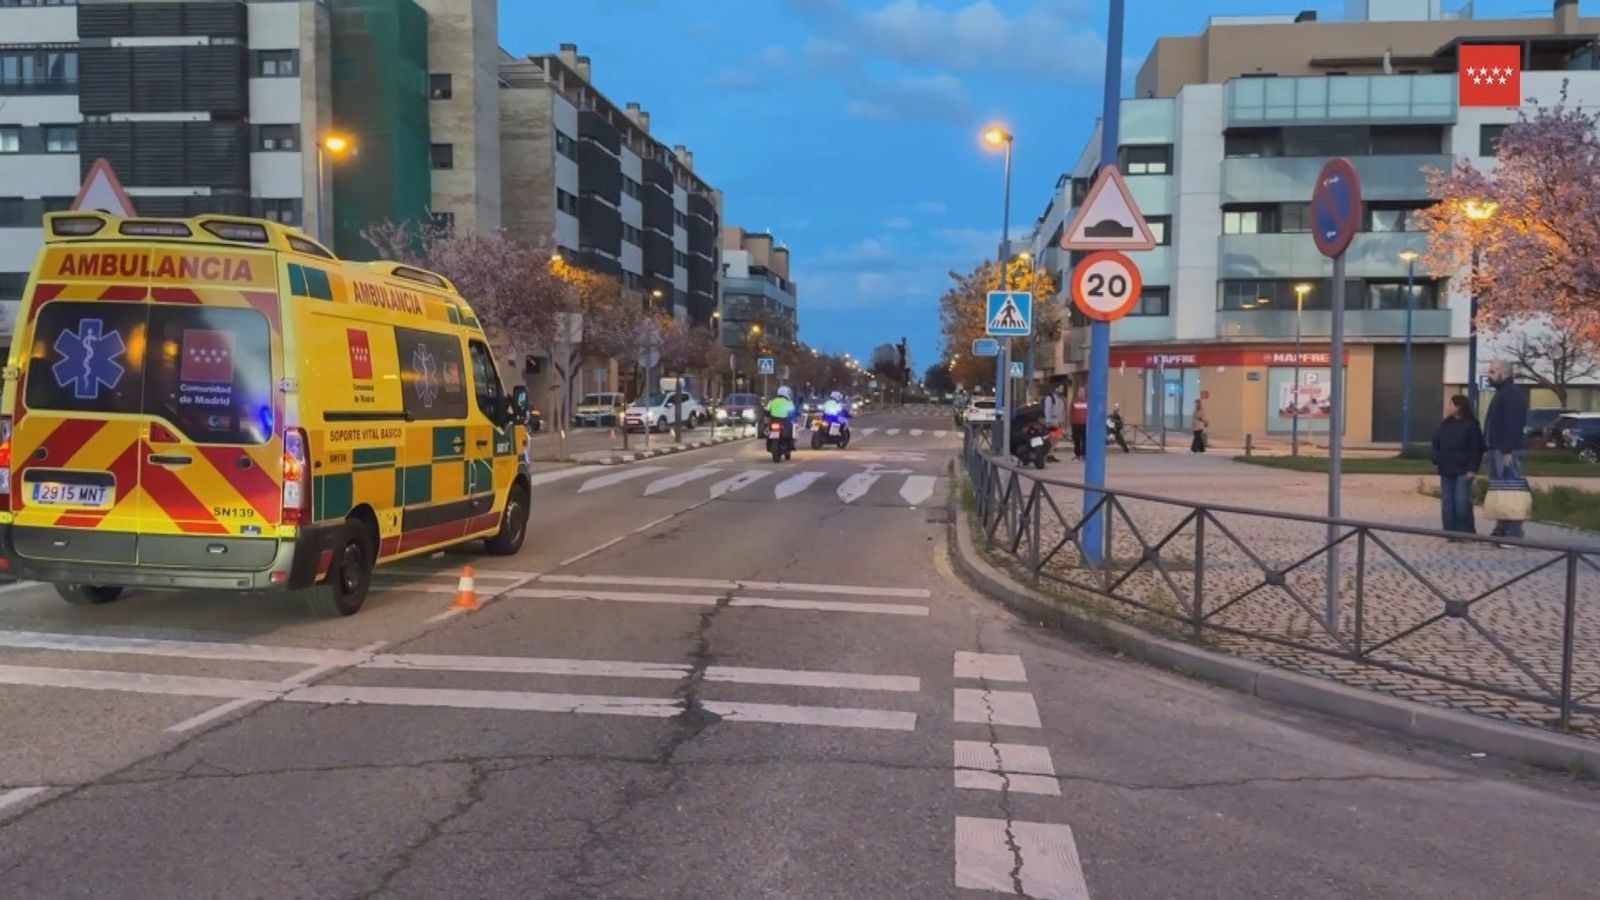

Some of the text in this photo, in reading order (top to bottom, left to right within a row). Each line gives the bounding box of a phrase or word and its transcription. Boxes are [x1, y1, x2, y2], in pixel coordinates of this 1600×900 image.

[58, 253, 254, 282] AMBULANCIA
[1087, 273, 1127, 298] 20
[352, 280, 423, 316] AMBULANCIA
[180, 384, 231, 394] Comunidad
[179, 395, 231, 406] de Madrid
[330, 429, 361, 442] SOPORTE
[362, 428, 379, 440] VITAL
[41, 485, 107, 502] 2915 MNT
[214, 506, 254, 517] SN139
